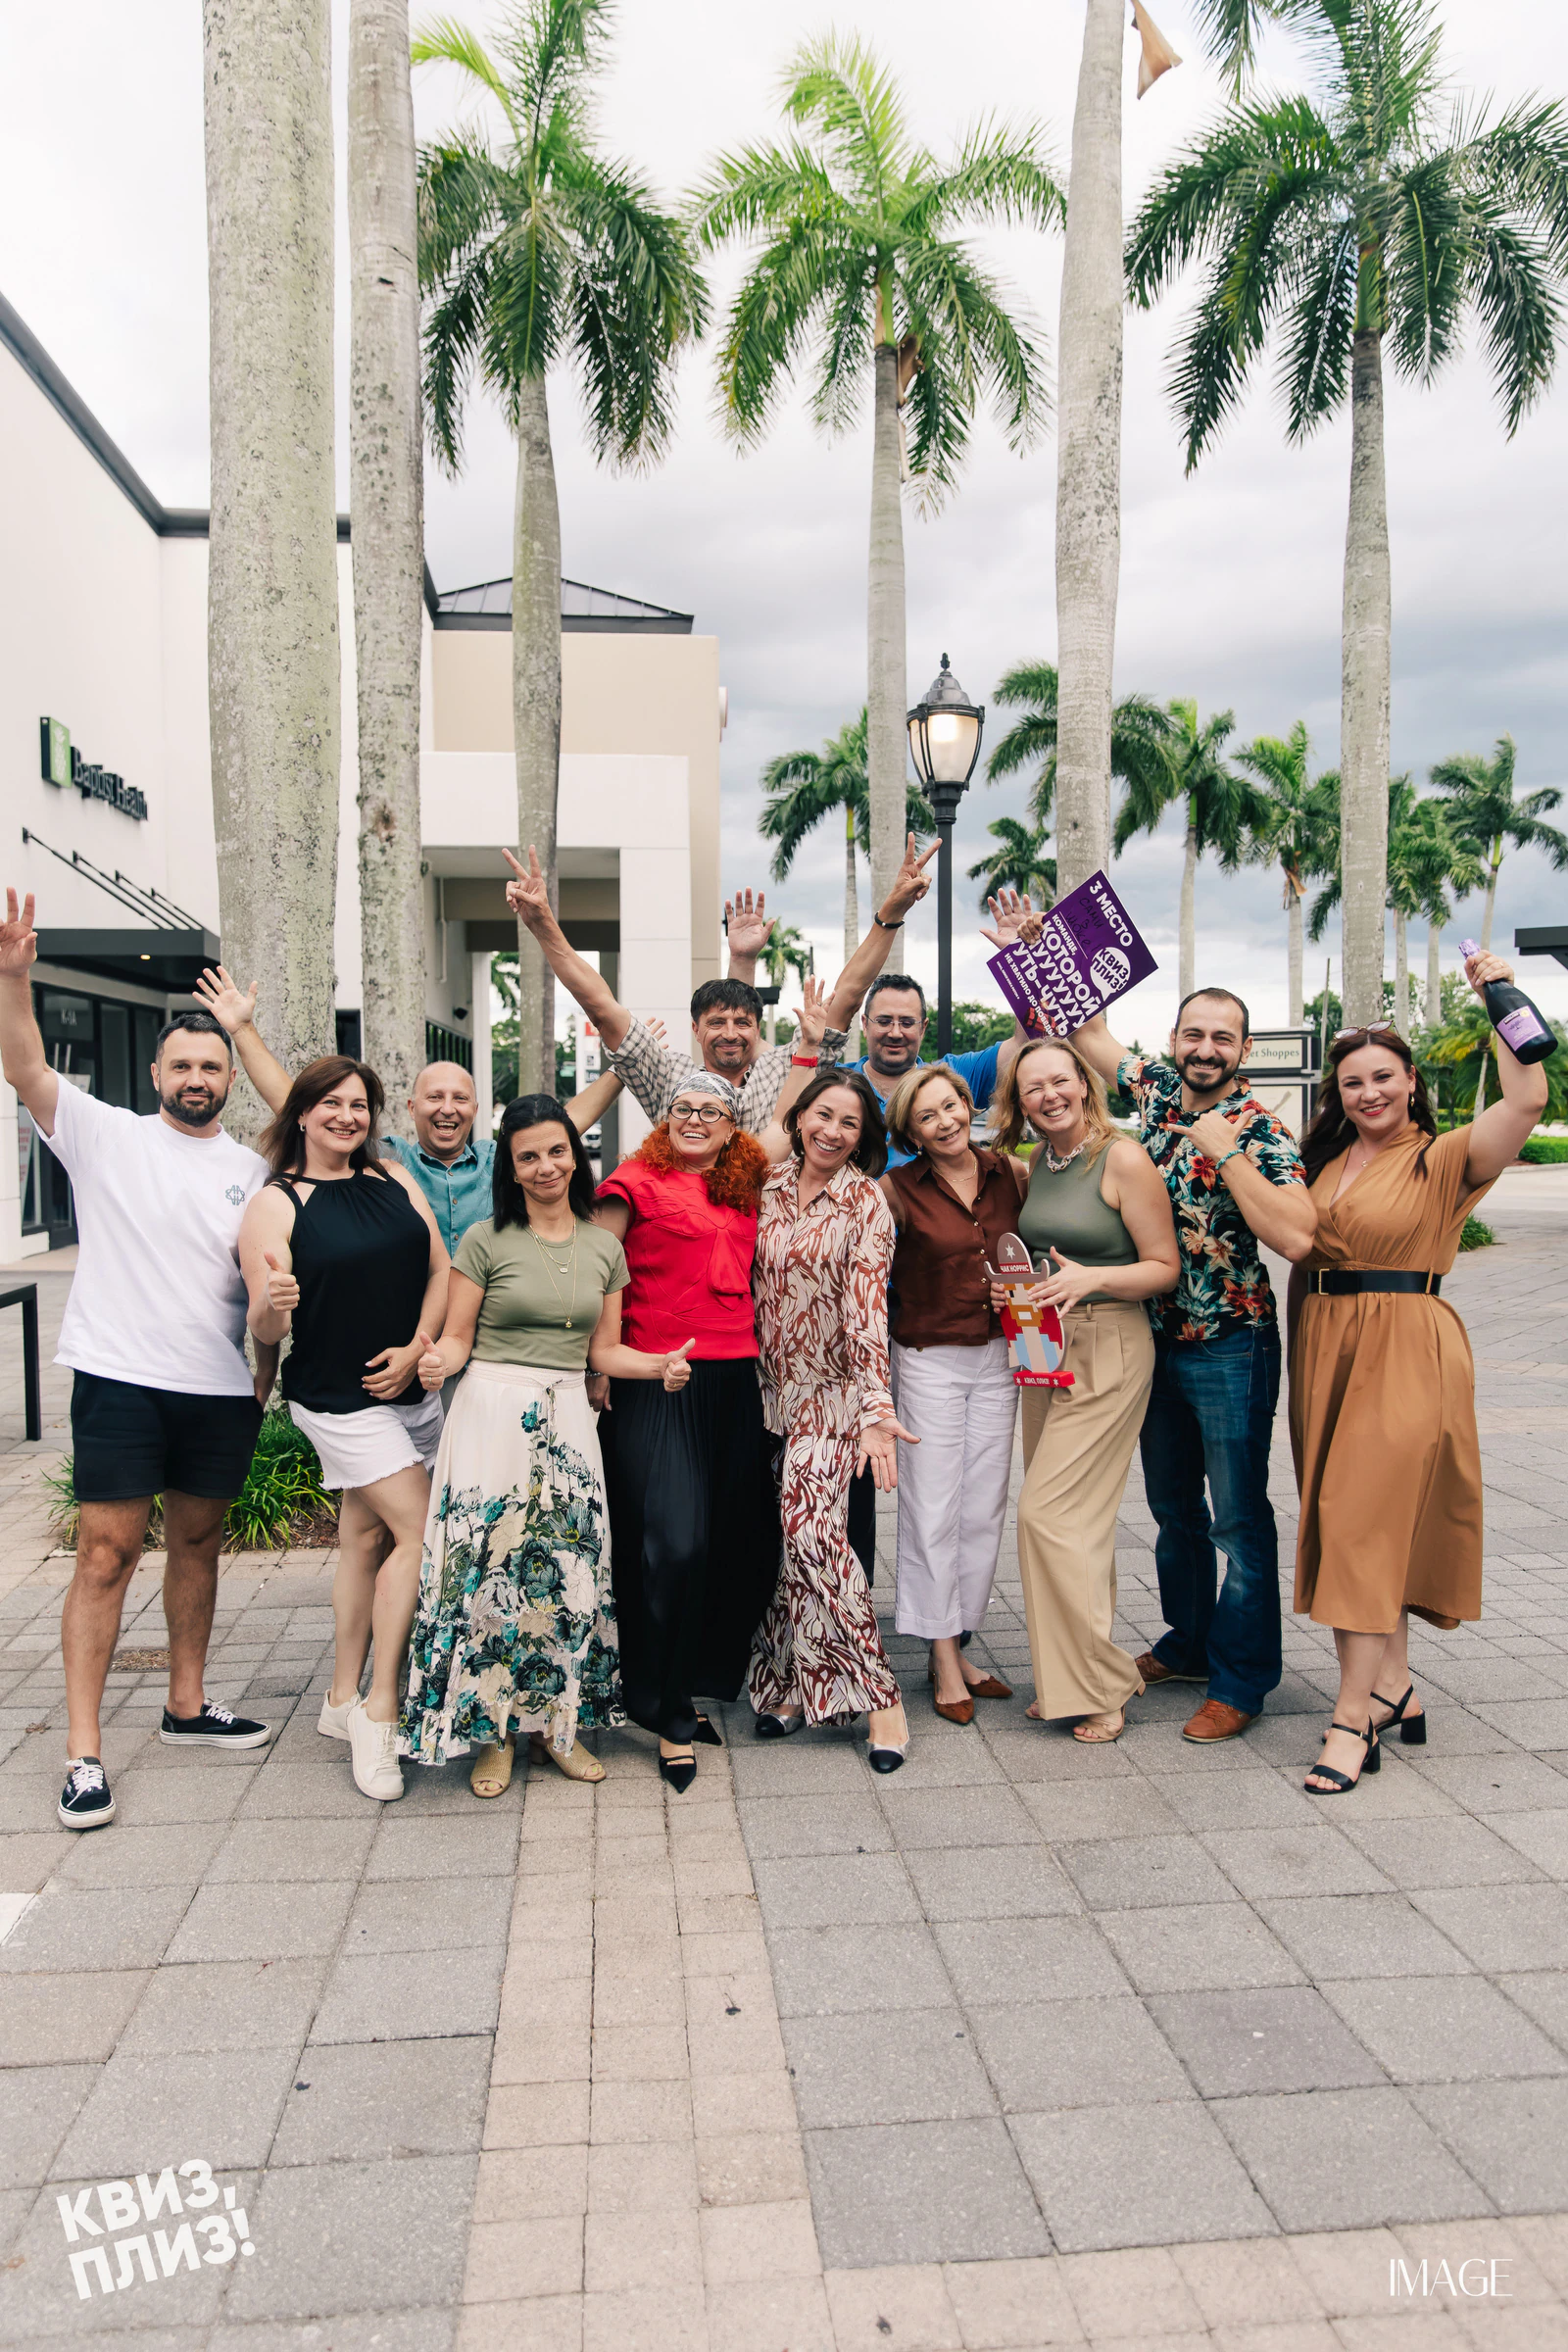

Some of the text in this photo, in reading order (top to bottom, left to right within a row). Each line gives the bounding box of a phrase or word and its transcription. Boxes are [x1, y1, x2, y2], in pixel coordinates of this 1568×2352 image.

[72, 746, 115, 804] Baptist
[1052, 913, 1079, 956] КОМАНДЕ,
[1089, 880, 1133, 947] 3 МЕСТО
[1004, 953, 1013, 964] НЕ
[1009, 962, 1031, 996] ХВАТИЛО
[1027, 995, 1038, 1007] ДО
[1034, 1005, 1055, 1038] ПОБЕДЫ
[1041, 920, 1102, 1016] КОТОРОЙ
[1260, 1048, 1300, 1060] Shoppes
